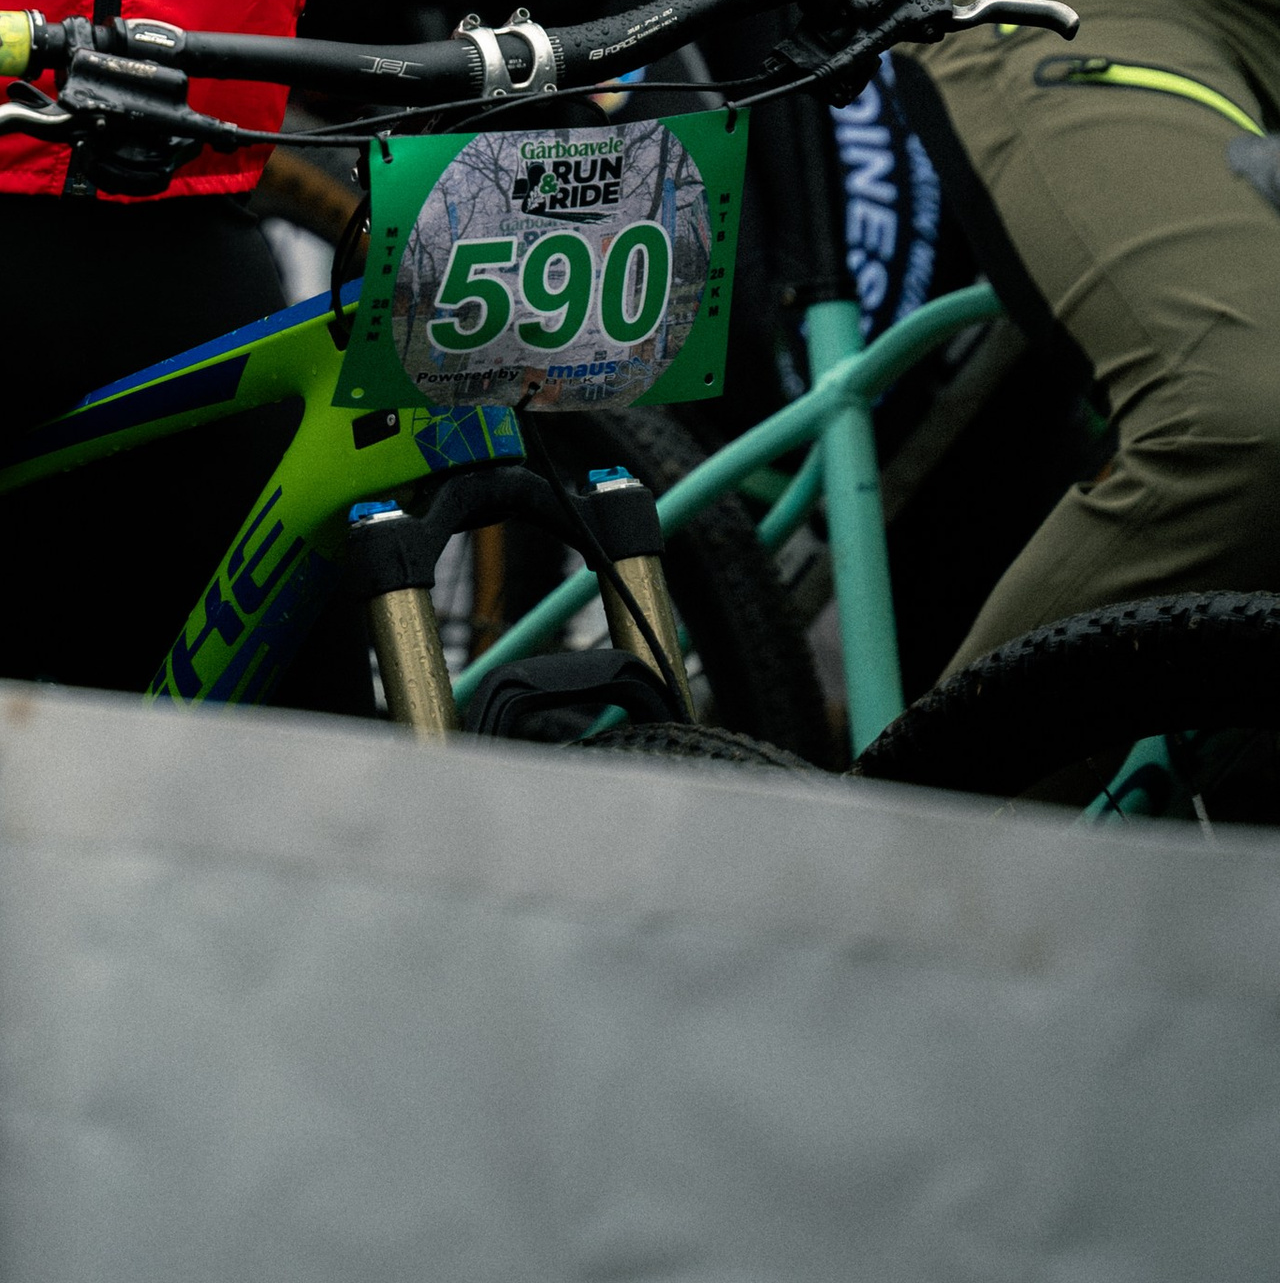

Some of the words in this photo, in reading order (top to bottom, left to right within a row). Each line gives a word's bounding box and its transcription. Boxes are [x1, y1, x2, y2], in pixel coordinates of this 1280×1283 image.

[605, 35, 637, 56] FORCE
[521, 137, 623, 160] Gârboavele
[552, 156, 623, 185] RUN
[548, 181, 621, 210] RIDE
[429, 222, 672, 352] 590
[417, 369, 494, 384] Powered
[497, 368, 520, 381] by
[547, 361, 617, 378] maus
